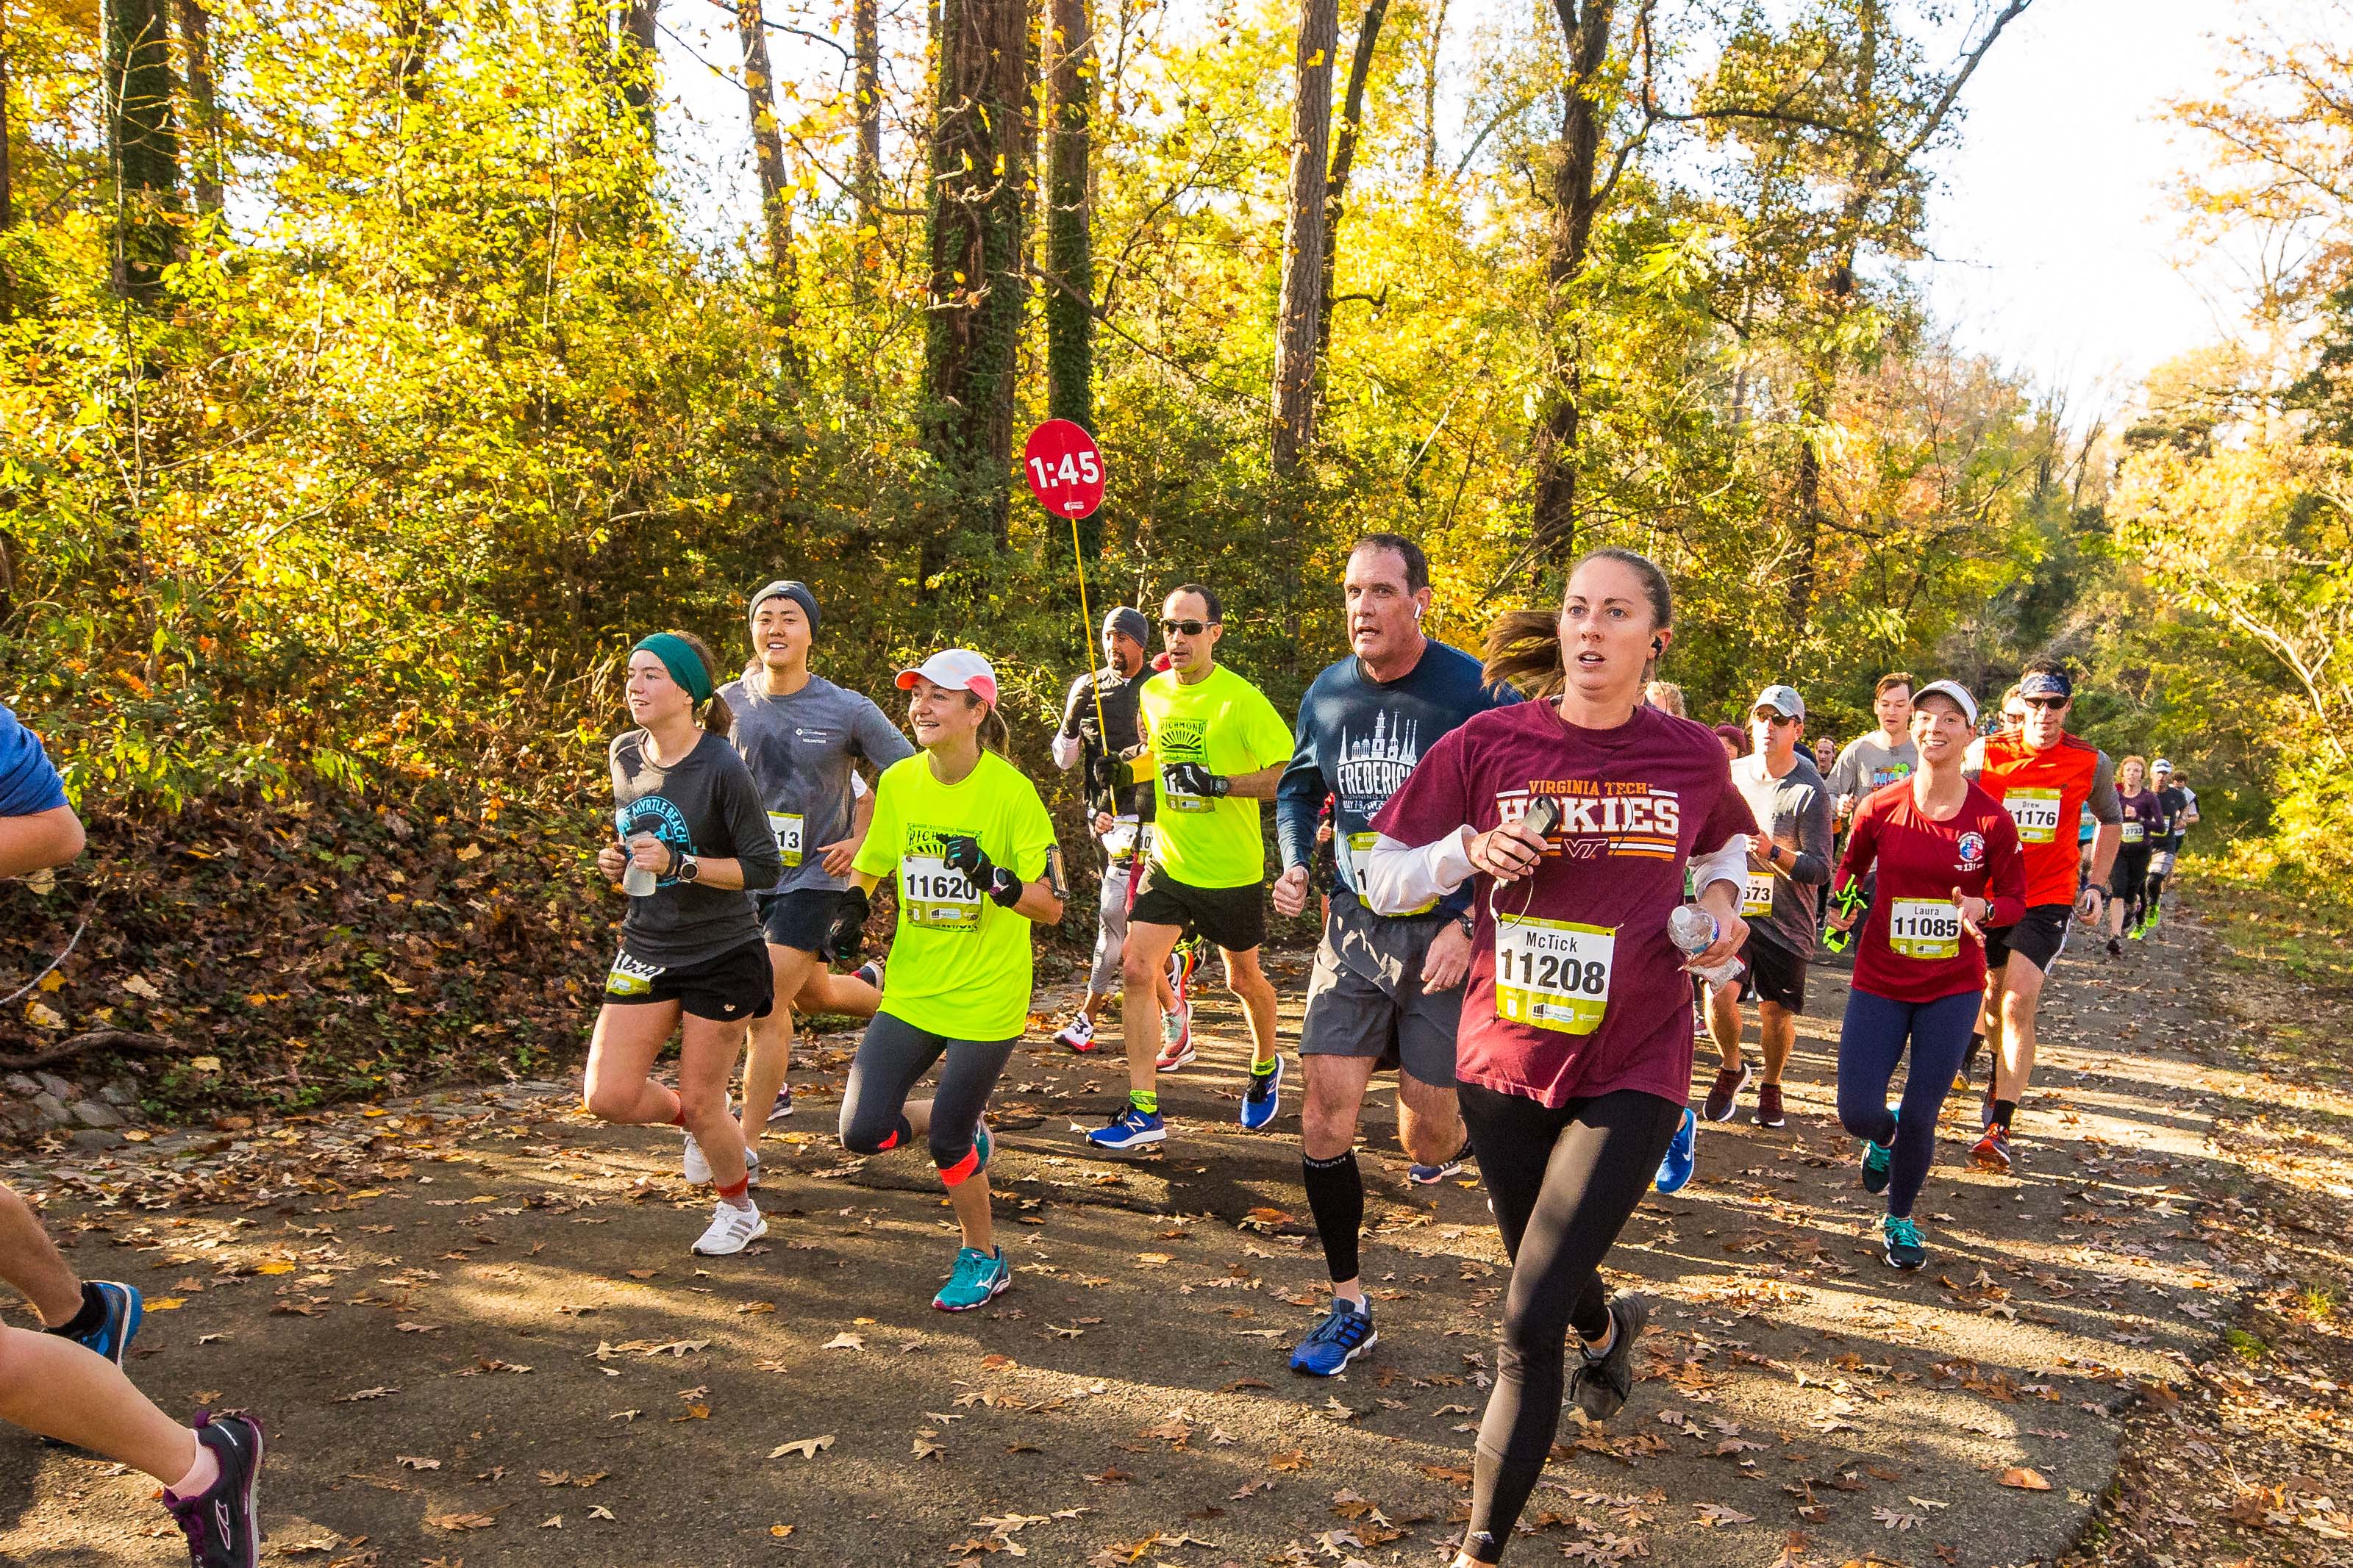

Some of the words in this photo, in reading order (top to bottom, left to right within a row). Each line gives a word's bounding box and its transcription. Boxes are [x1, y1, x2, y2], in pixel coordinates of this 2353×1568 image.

[1029, 451, 1099, 489] 1:45
[1529, 780, 1601, 796] VIRGINIA
[1604, 781, 1649, 795] TECH
[1343, 800, 1354, 809] MAY
[1354, 800, 1363, 809] 7-8
[2022, 801, 2040, 809] Drew
[632, 798, 668, 817] MYRTLE
[665, 807, 688, 844] BEACH
[1498, 796, 1679, 835] HKIES
[2008, 809, 2057, 826] 1176
[907, 873, 978, 901] 11620
[1915, 906, 1940, 916] Laura
[1894, 917, 1960, 937] 11085
[1526, 931, 1579, 953] McTick
[1501, 948, 1606, 995] 11208
[1507, 999, 1518, 1017] B
